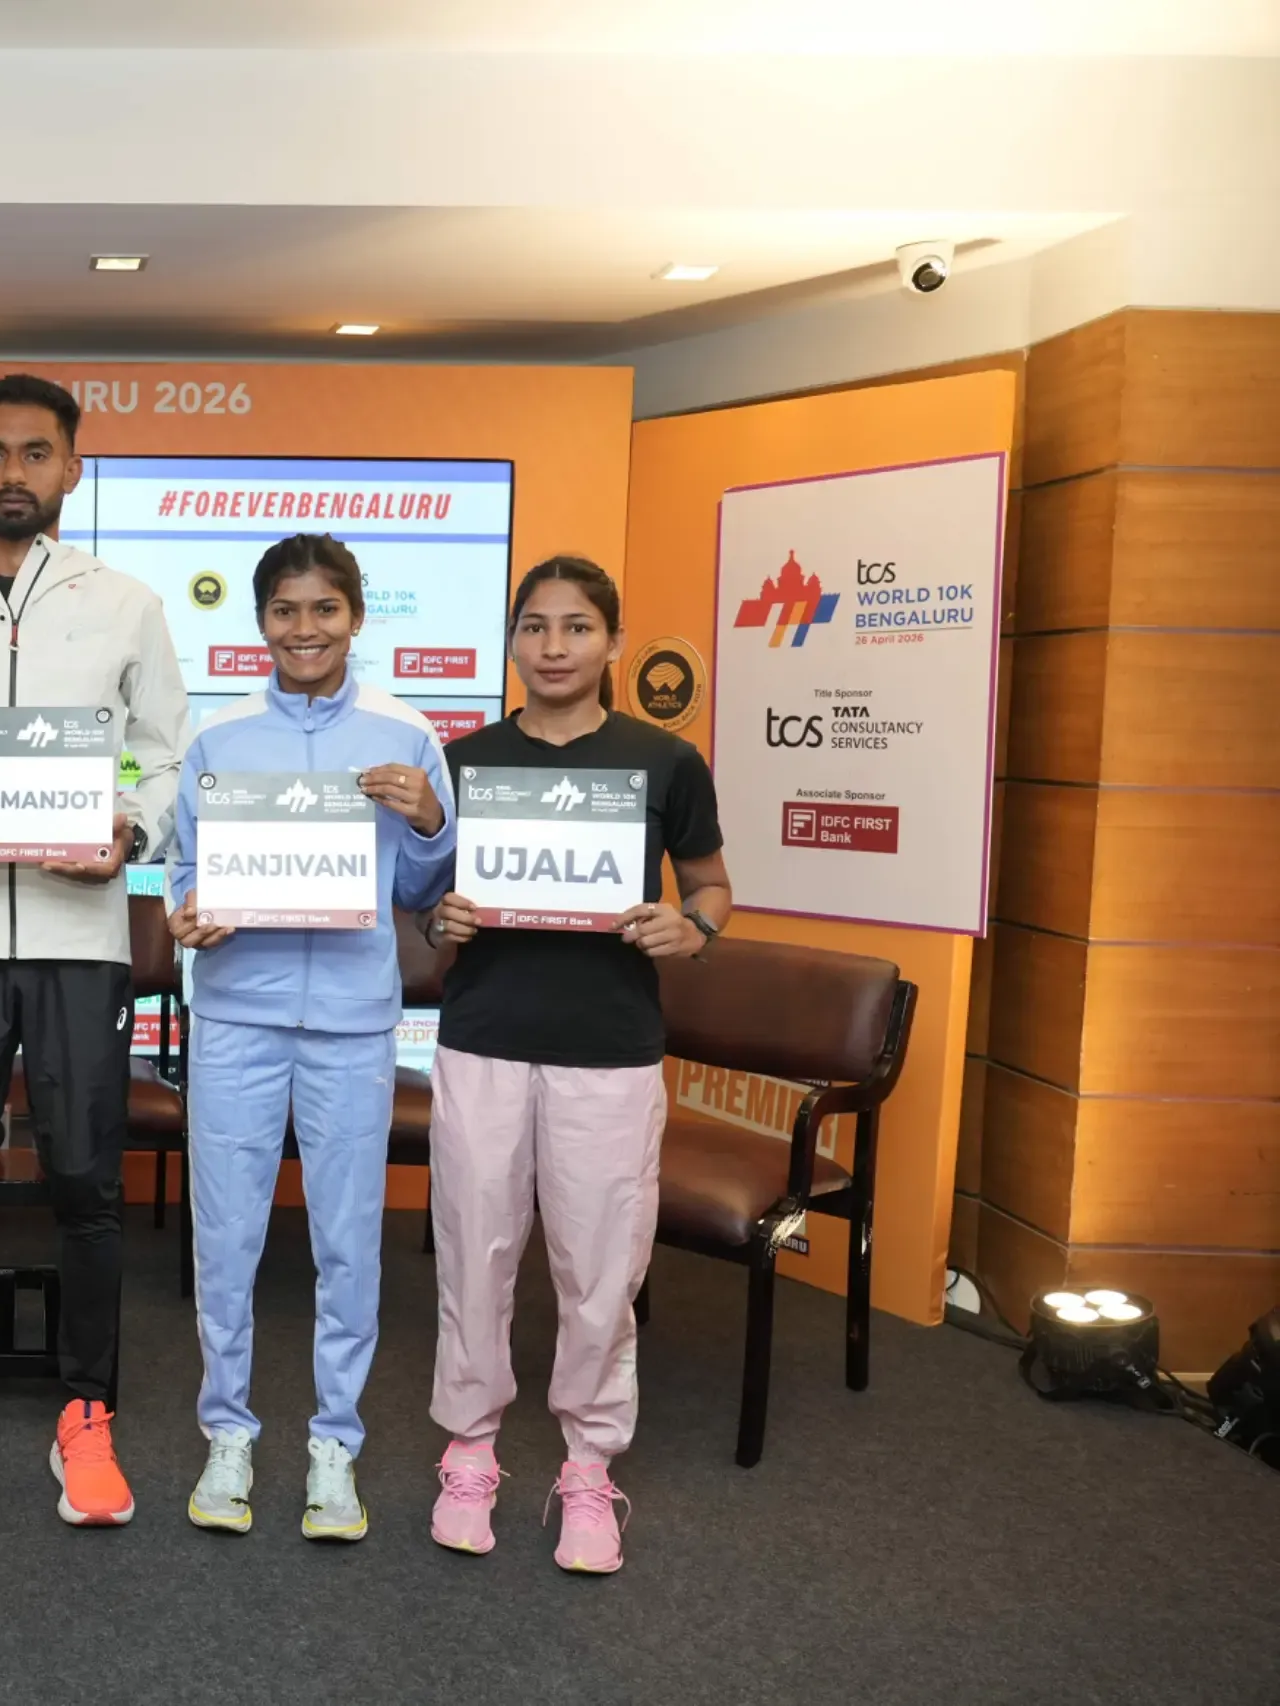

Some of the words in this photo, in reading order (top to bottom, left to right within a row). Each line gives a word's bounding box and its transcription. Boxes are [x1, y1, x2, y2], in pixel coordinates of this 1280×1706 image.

[154, 381, 252, 414] 2026
[158, 490, 451, 520] #FOREVERBENGALURU
[857, 559, 896, 585] tcs
[366, 590, 391, 600] RLD
[394, 590, 417, 601] 10K
[857, 587, 931, 607] WORLD
[937, 584, 973, 601] 10K
[367, 604, 418, 614] GALURU
[855, 607, 974, 628] BENGALURU
[855, 636, 867, 645] 26
[870, 635, 895, 645] April
[898, 633, 924, 643] 2026
[423, 656, 442, 665] IDFC
[444, 655, 469, 665] FIRST
[423, 665, 444, 674] Bank
[814, 689, 832, 698] Title
[835, 689, 873, 699] Sponsor
[832, 706, 870, 718] TATA
[431, 720, 448, 728] DFC
[451, 719, 476, 728] FIRST
[766, 707, 823, 748] tcs
[831, 721, 924, 734] CONSULTANCY
[831, 737, 888, 750] SERVICES
[206, 791, 230, 804] tcs
[468, 785, 493, 801] tcs
[796, 788, 842, 799] Associate
[844, 790, 886, 801] Sponsor
[821, 815, 850, 828] IDFC
[854, 817, 892, 831] FIRST
[820, 830, 852, 844] Bank
[19, 849, 44, 857] FIRST
[46, 849, 67, 857] Bank
[207, 853, 367, 877] SANJIVANI
[475, 845, 623, 885] UJALA
[258, 914, 278, 922] IDFC
[281, 914, 306, 922] FIRST
[308, 915, 331, 923] Bank
[517, 915, 539, 924] IDFC
[541, 916, 567, 925] FIRST
[569, 917, 593, 926] Bank
